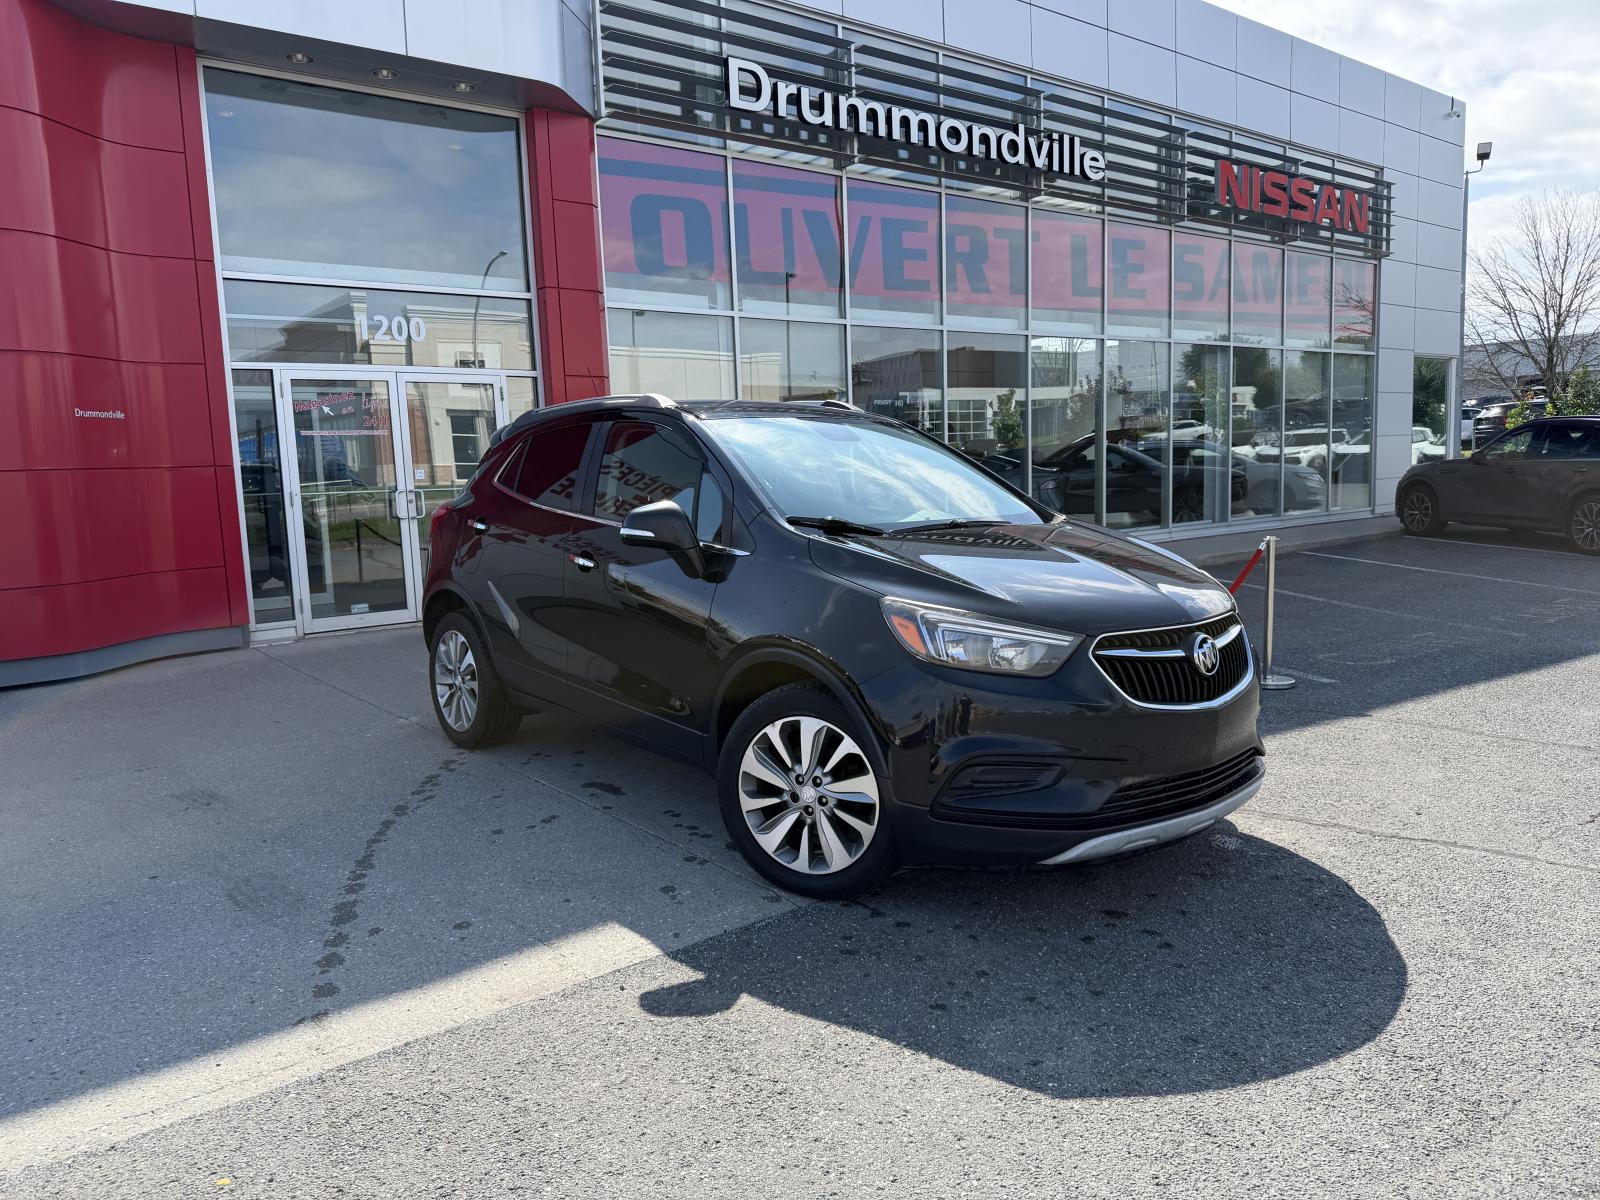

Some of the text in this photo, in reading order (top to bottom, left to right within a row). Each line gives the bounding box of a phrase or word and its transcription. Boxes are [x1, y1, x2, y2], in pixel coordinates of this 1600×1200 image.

[727, 56, 1107, 183] Drummondville
[1215, 159, 1369, 234] NISSAN
[630, 193, 1039, 296] OUVERT
[1071, 234, 1146, 299] LE
[357, 314, 426, 342] 1200
[75, 408, 125, 419] Drummondville
